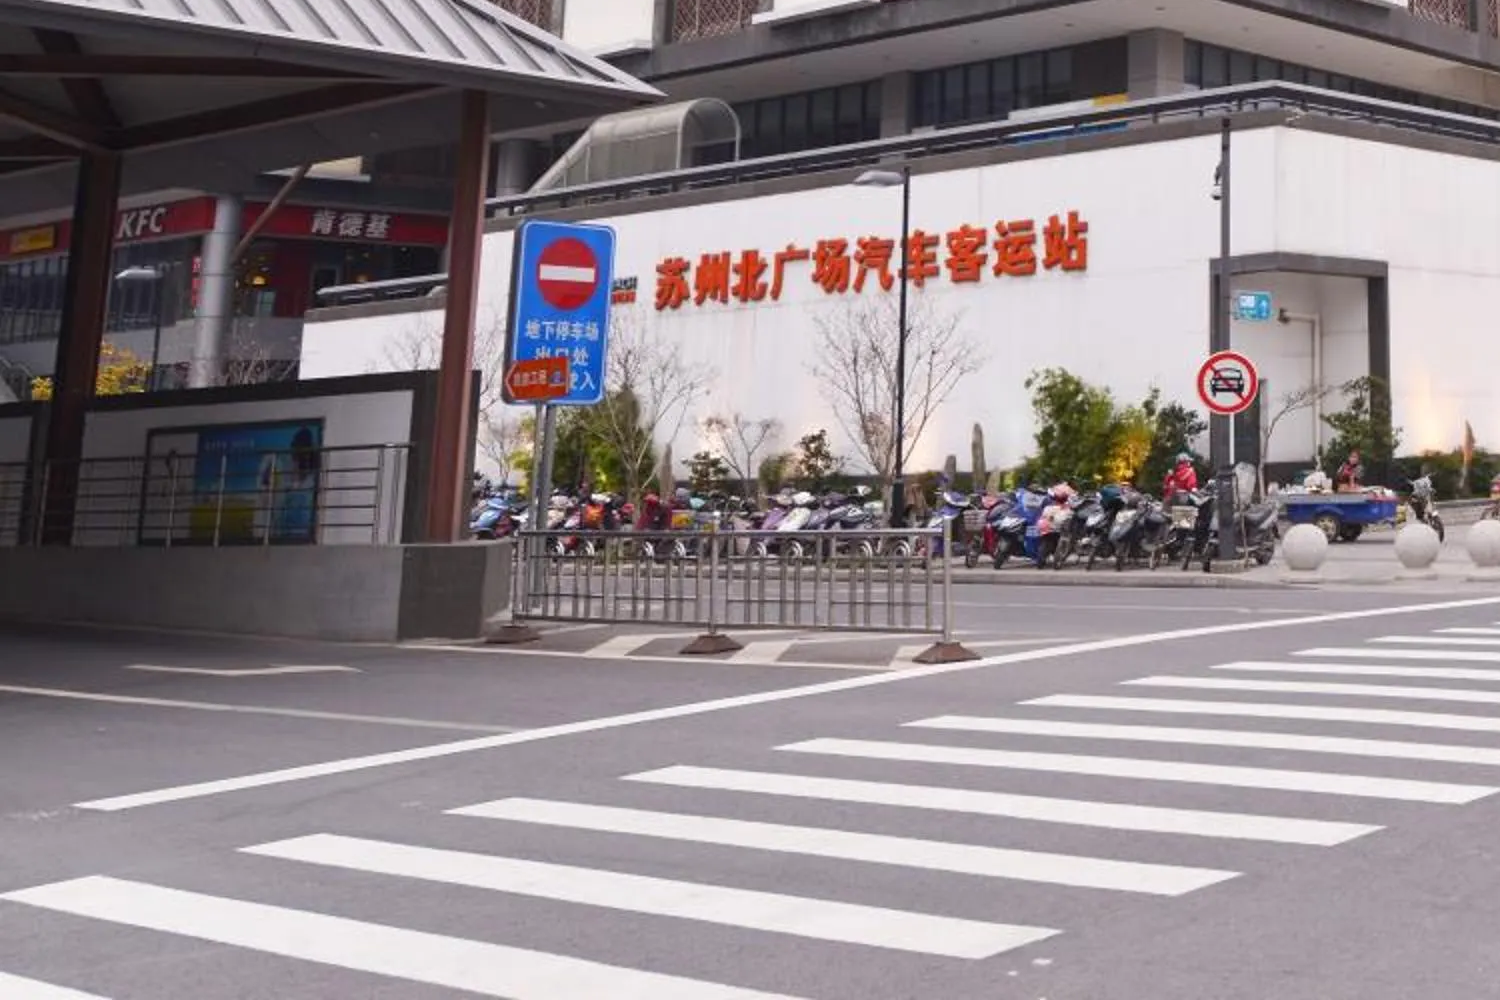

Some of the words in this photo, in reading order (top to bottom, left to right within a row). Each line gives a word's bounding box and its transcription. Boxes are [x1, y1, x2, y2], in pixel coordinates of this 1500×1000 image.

[117, 207, 166, 240] KFC
[311, 209, 391, 239] 肯德基
[654, 210, 1089, 311] 苏州北广场汽车客运站
[525, 319, 599, 341] 地下停车场
